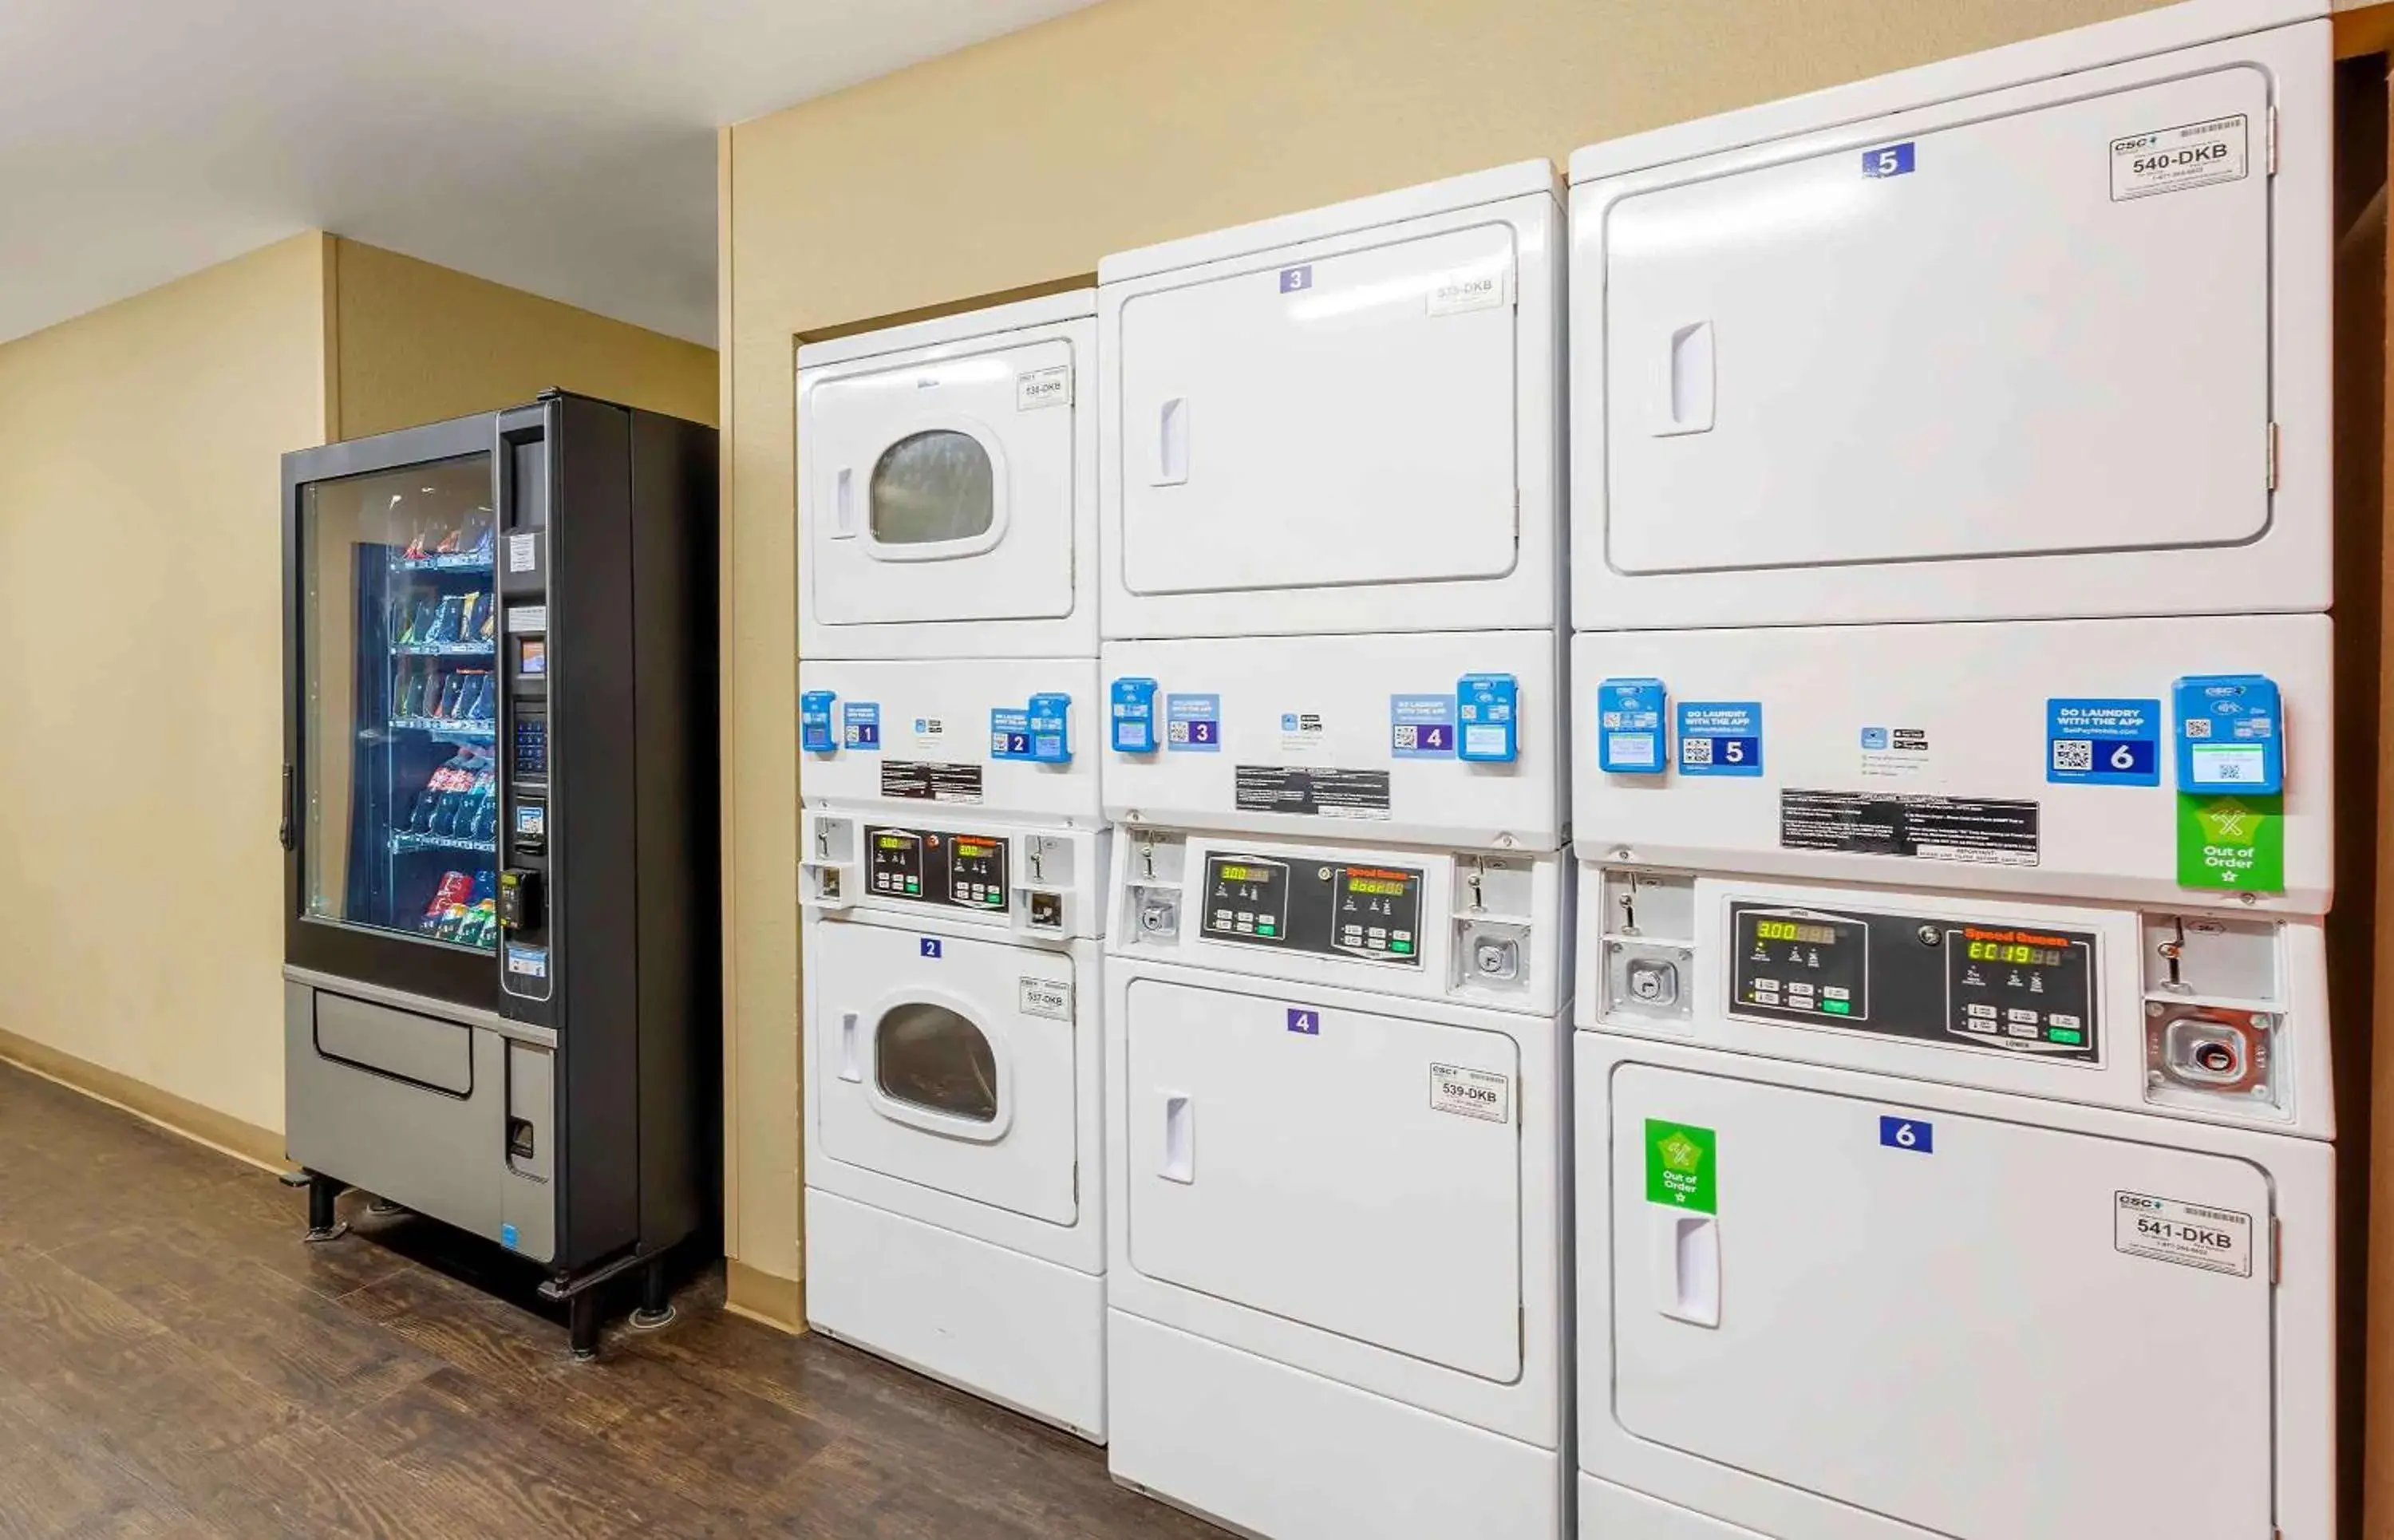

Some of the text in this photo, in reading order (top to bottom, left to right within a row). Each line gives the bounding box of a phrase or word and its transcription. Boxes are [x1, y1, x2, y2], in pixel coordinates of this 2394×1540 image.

[2115, 137, 2147, 152] CSC
[1878, 151, 1898, 174] 5
[2133, 143, 2228, 173] 540-DKB
[1290, 270, 1302, 288] 3
[2060, 708, 2140, 717] DO LAUNDRY
[2056, 717, 2089, 725] WITH
[2119, 717, 2144, 726] APP
[864, 727, 871, 741] 1
[1197, 724, 1208, 741] 3
[1427, 729, 1442, 747] 4
[1014, 736, 1024, 751] 2
[1725, 741, 1744, 762] 5
[2111, 744, 2134, 769] 6
[2204, 846, 2255, 858] Out of
[2205, 856, 2254, 868] Order
[1965, 927, 2069, 947] Speed Queen
[926, 941, 935, 955] 2
[1296, 1013, 1310, 1031] 4
[1442, 1082, 1497, 1104] 539-DKB
[1895, 1123, 1916, 1147] 6
[1663, 1170, 1698, 1184] Out of
[1664, 1179, 1697, 1193] Order
[2119, 1195, 2153, 1207] CSC
[2137, 1218, 2232, 1249] 541-DKB
